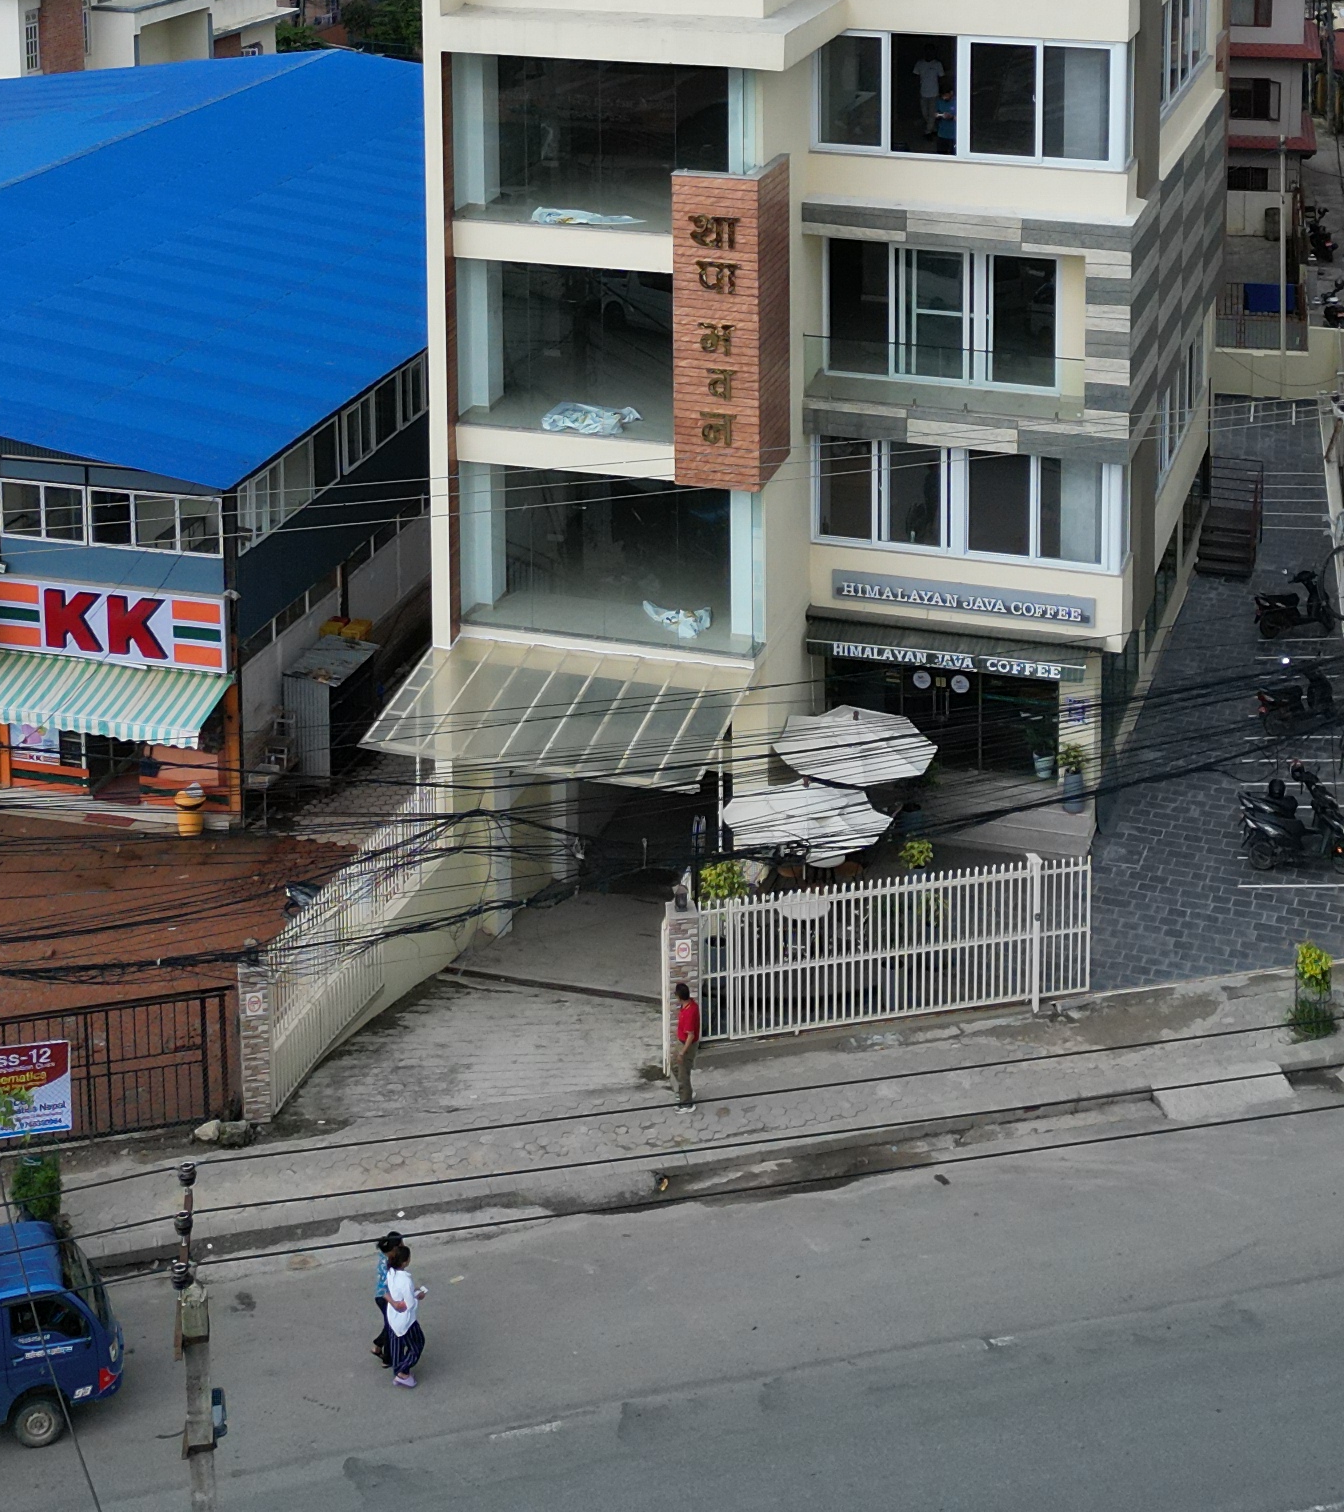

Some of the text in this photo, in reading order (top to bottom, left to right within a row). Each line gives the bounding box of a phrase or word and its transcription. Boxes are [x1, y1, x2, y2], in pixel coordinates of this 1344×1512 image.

[841, 581, 1083, 622] HIMALAYAN JAVA COFFEE
[43, 588, 169, 661] KK
[833, 641, 1062, 679] HIMALAYAN JAVA COFFEE
